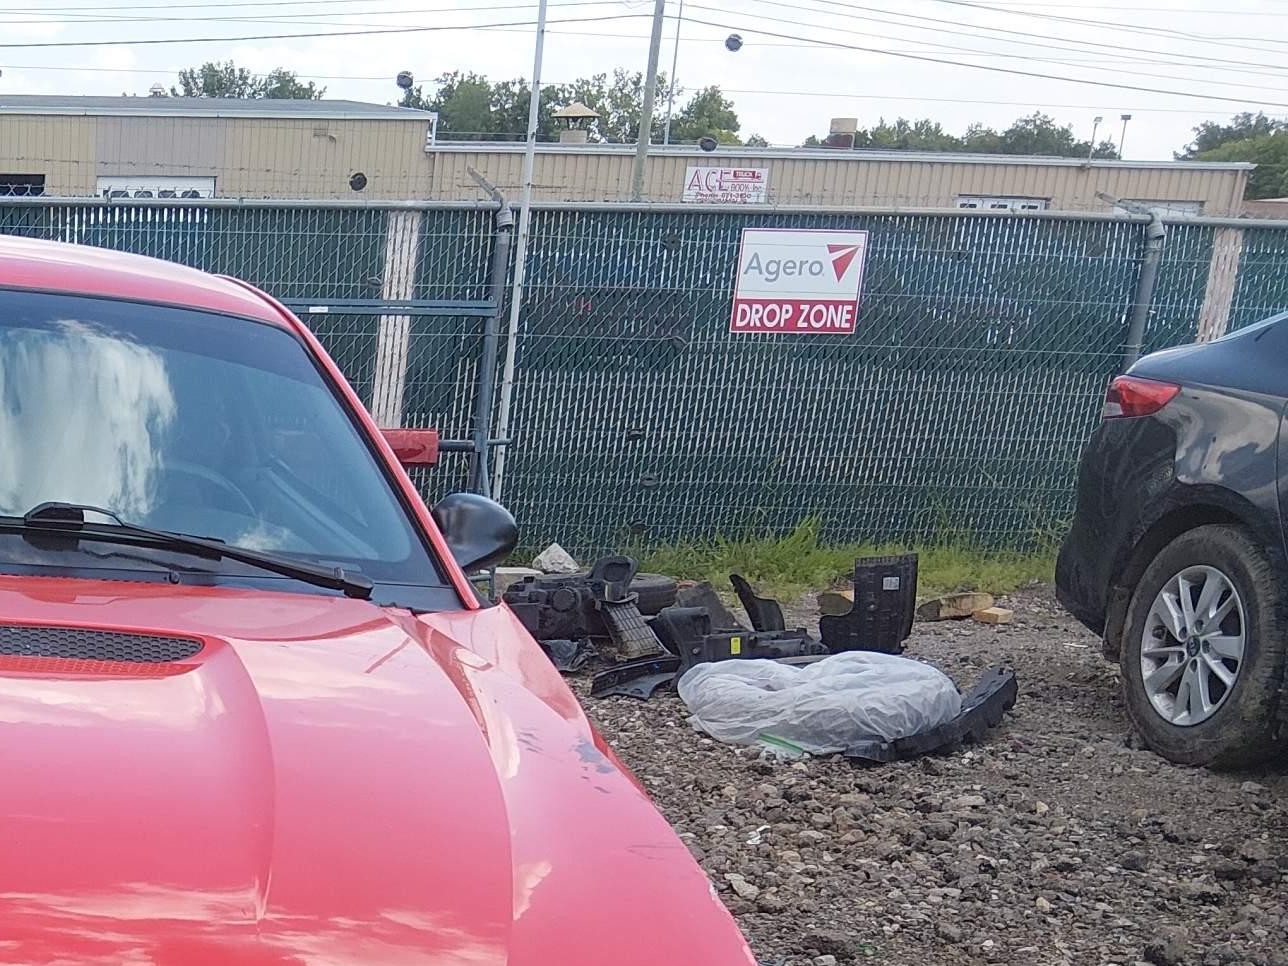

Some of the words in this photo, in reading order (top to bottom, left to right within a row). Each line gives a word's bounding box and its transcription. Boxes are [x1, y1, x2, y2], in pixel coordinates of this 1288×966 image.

[743, 251, 825, 283] Agero
[735, 303, 793, 328] DROP
[796, 304, 853, 328] ZONE
